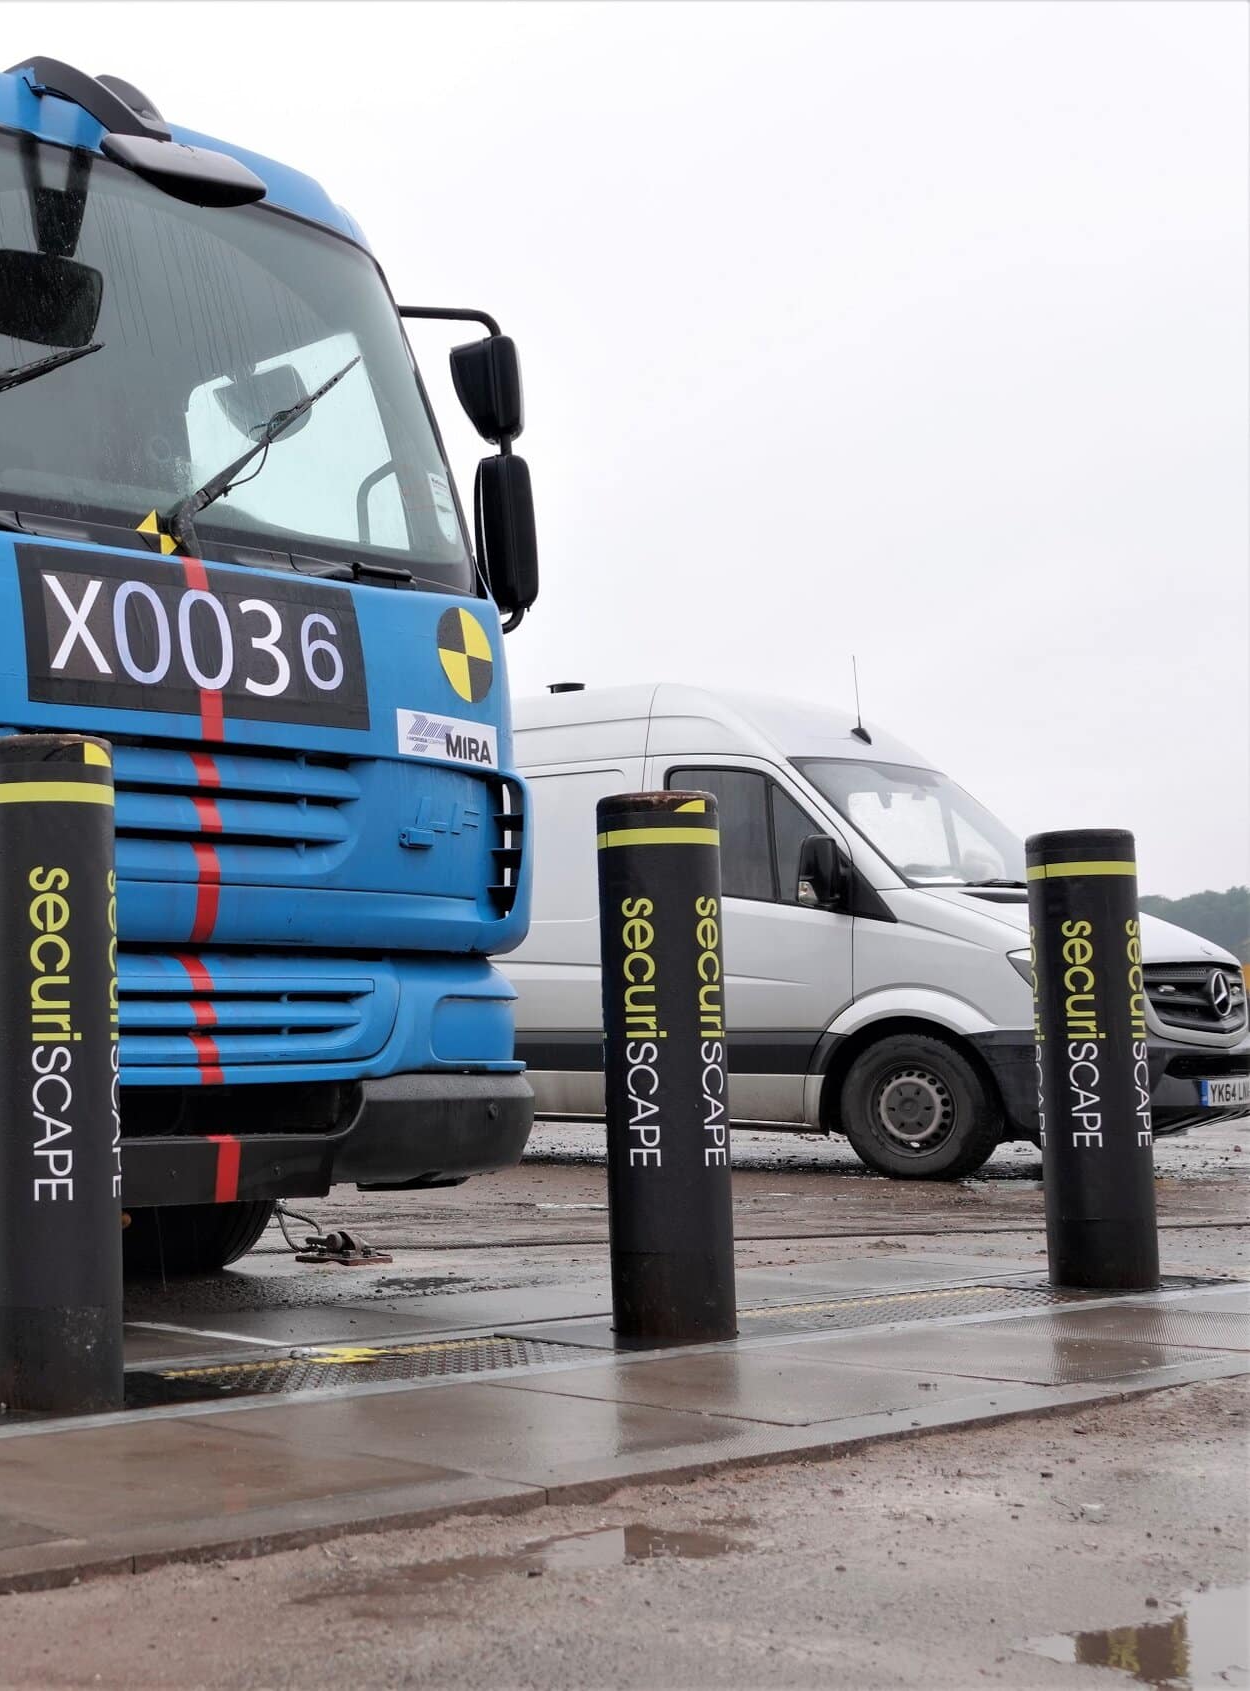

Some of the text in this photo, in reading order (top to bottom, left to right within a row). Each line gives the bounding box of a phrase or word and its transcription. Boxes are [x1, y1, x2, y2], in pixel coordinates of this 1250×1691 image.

[42, 574, 344, 696] X0036
[445, 733, 492, 765] MIRA
[28, 866, 82, 1201] securiSCAPE
[621, 896, 668, 1168] securiSCAPE
[695, 895, 727, 1168] securiSCAPE
[1061, 919, 1106, 1148] securiSCAPE
[1210, 1083, 1237, 1103] YK64
